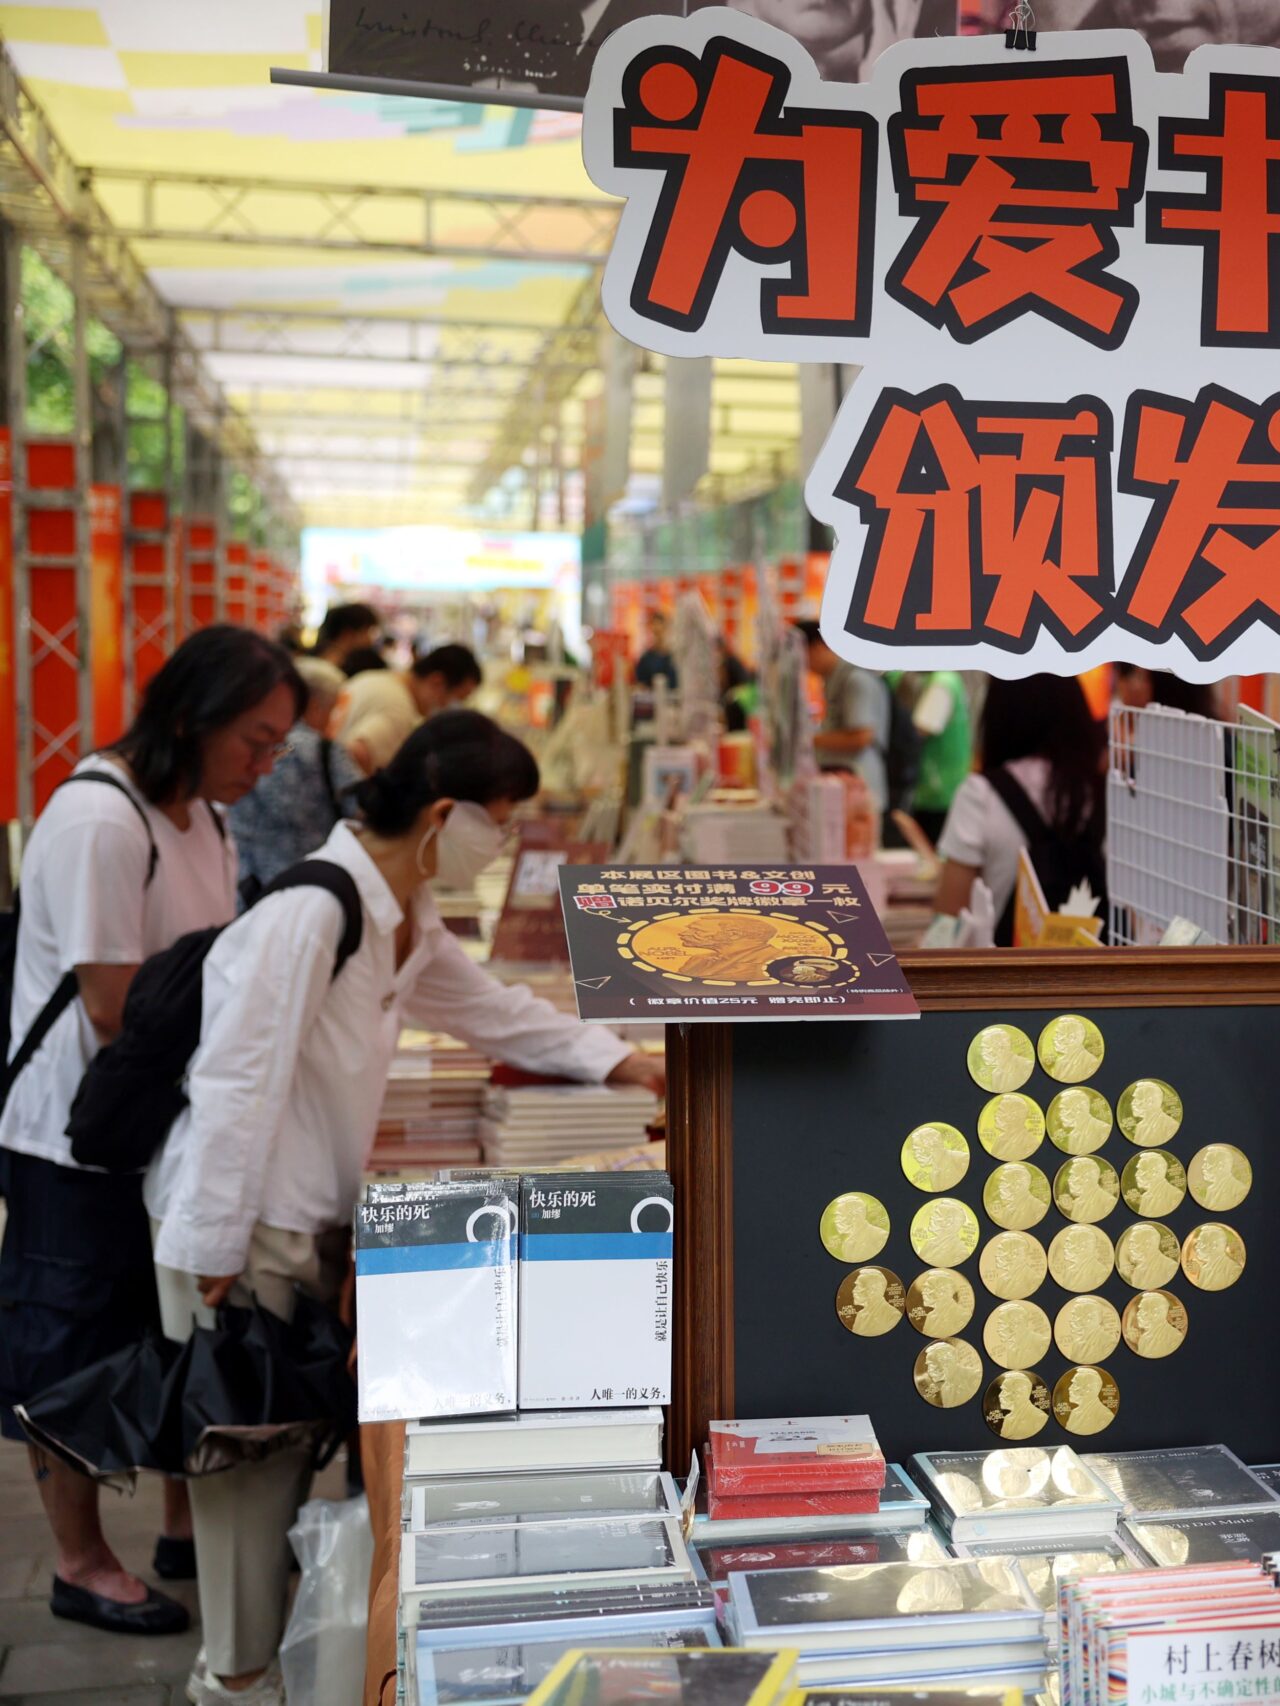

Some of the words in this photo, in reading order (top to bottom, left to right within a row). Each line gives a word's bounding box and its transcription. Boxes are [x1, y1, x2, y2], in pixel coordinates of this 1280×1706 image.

[529, 1189, 597, 1209] 快乐的死
[360, 1203, 431, 1224] 快乐的死
